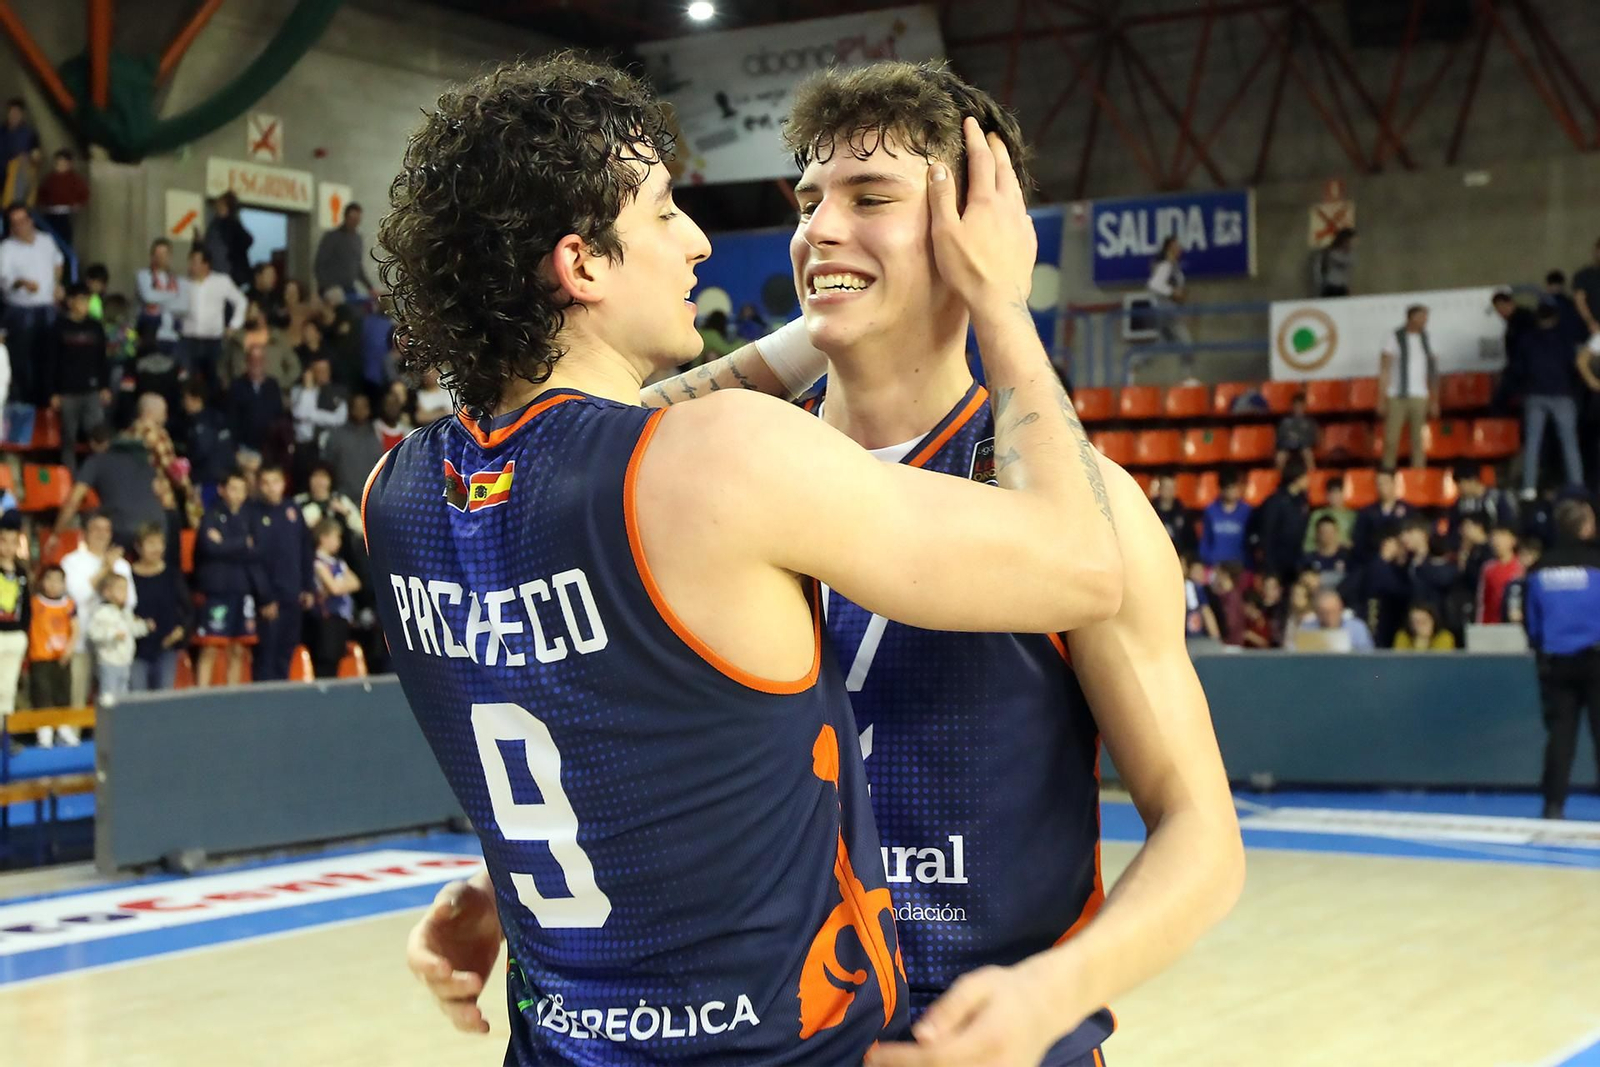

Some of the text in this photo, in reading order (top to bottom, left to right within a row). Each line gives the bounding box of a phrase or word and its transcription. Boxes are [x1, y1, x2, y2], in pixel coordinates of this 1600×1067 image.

[1098, 206, 1206, 257] SALIDA
[390, 567, 609, 667] PACHECO
[470, 702, 612, 929] 9
[535, 993, 761, 1042] IBEREÓLICA
